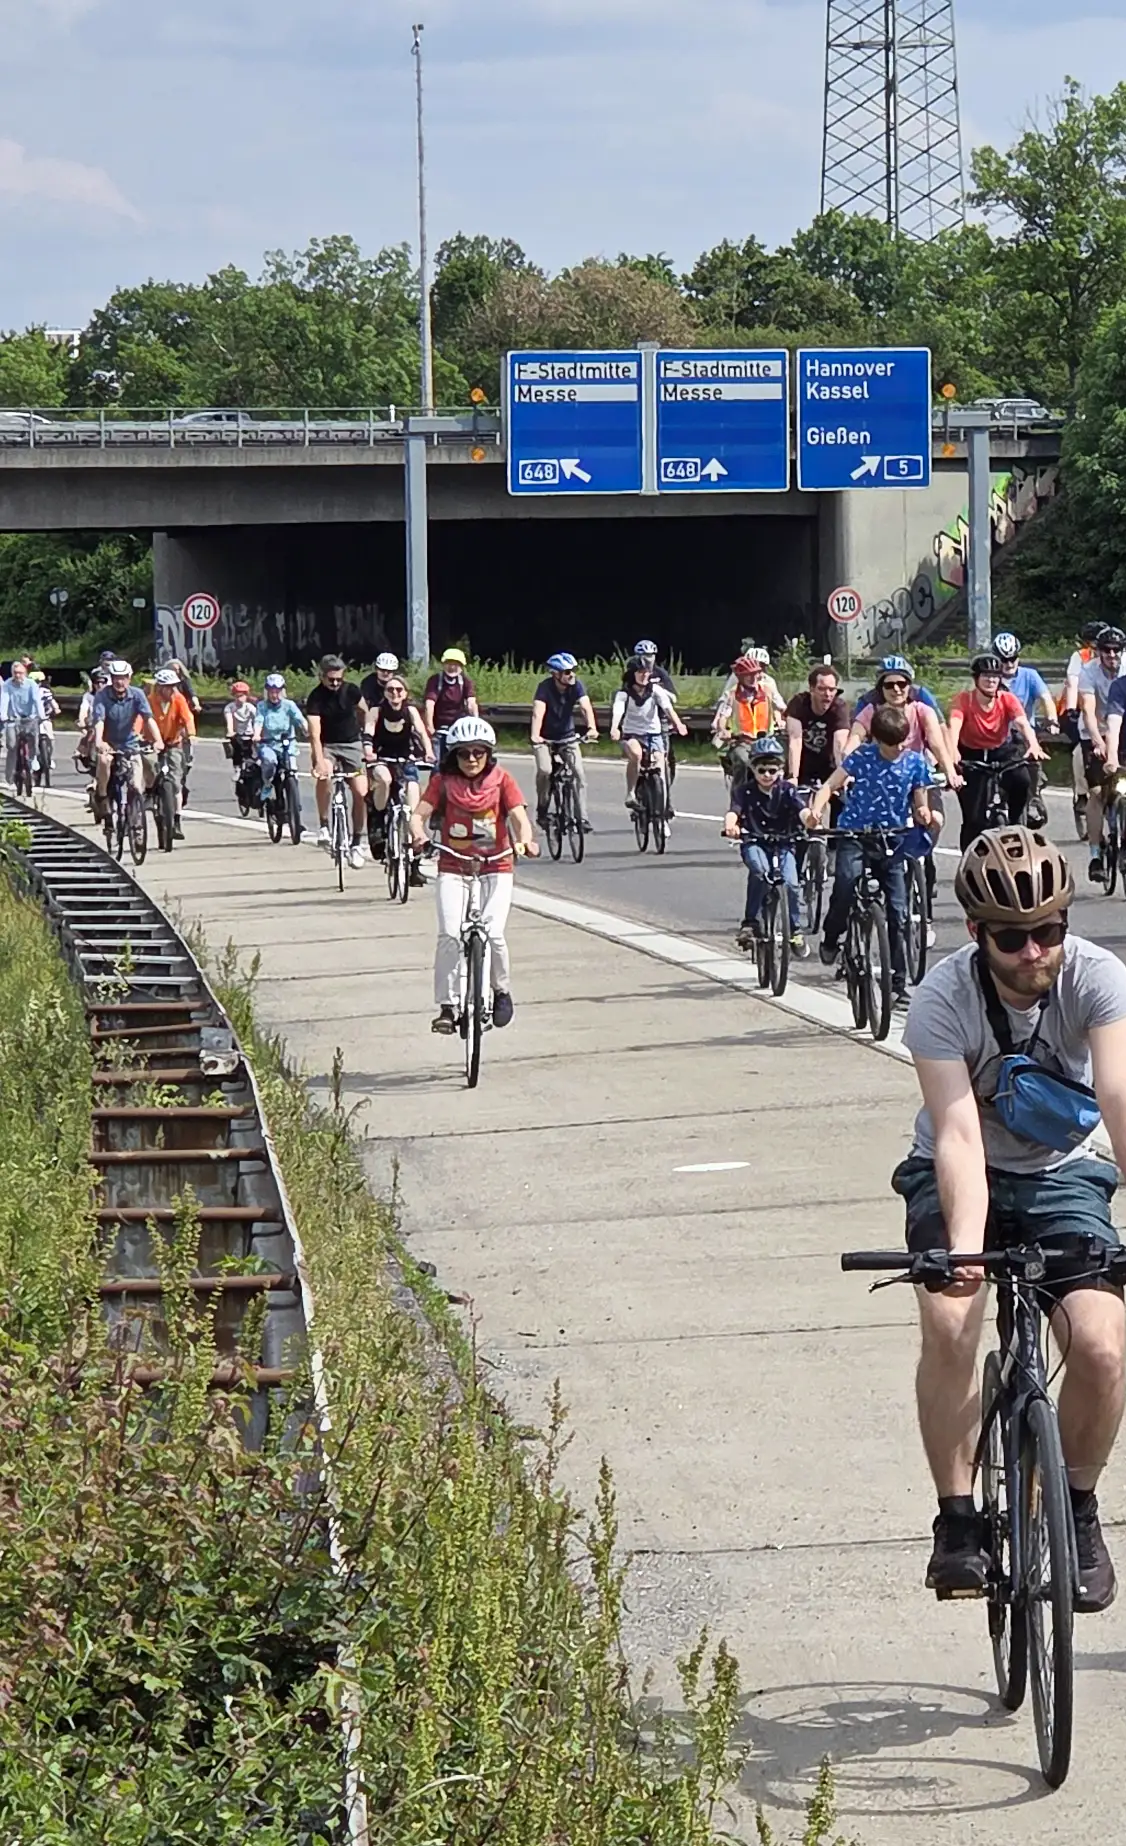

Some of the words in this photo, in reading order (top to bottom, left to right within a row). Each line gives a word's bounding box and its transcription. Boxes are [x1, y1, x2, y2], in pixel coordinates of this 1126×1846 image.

[518, 362, 631, 379] F-Stadtmitte
[663, 361, 771, 378] F-Stadtmitte
[806, 360, 895, 377] Hannover
[518, 385, 577, 402] Messe
[664, 385, 723, 401] Messe
[806, 382, 870, 399] Kassel
[806, 428, 871, 445] Gießen
[524, 463, 554, 480] 648
[666, 462, 696, 478] 648
[899, 460, 909, 475] 5
[191, 604, 211, 620] 120
[835, 596, 856, 612] 120
